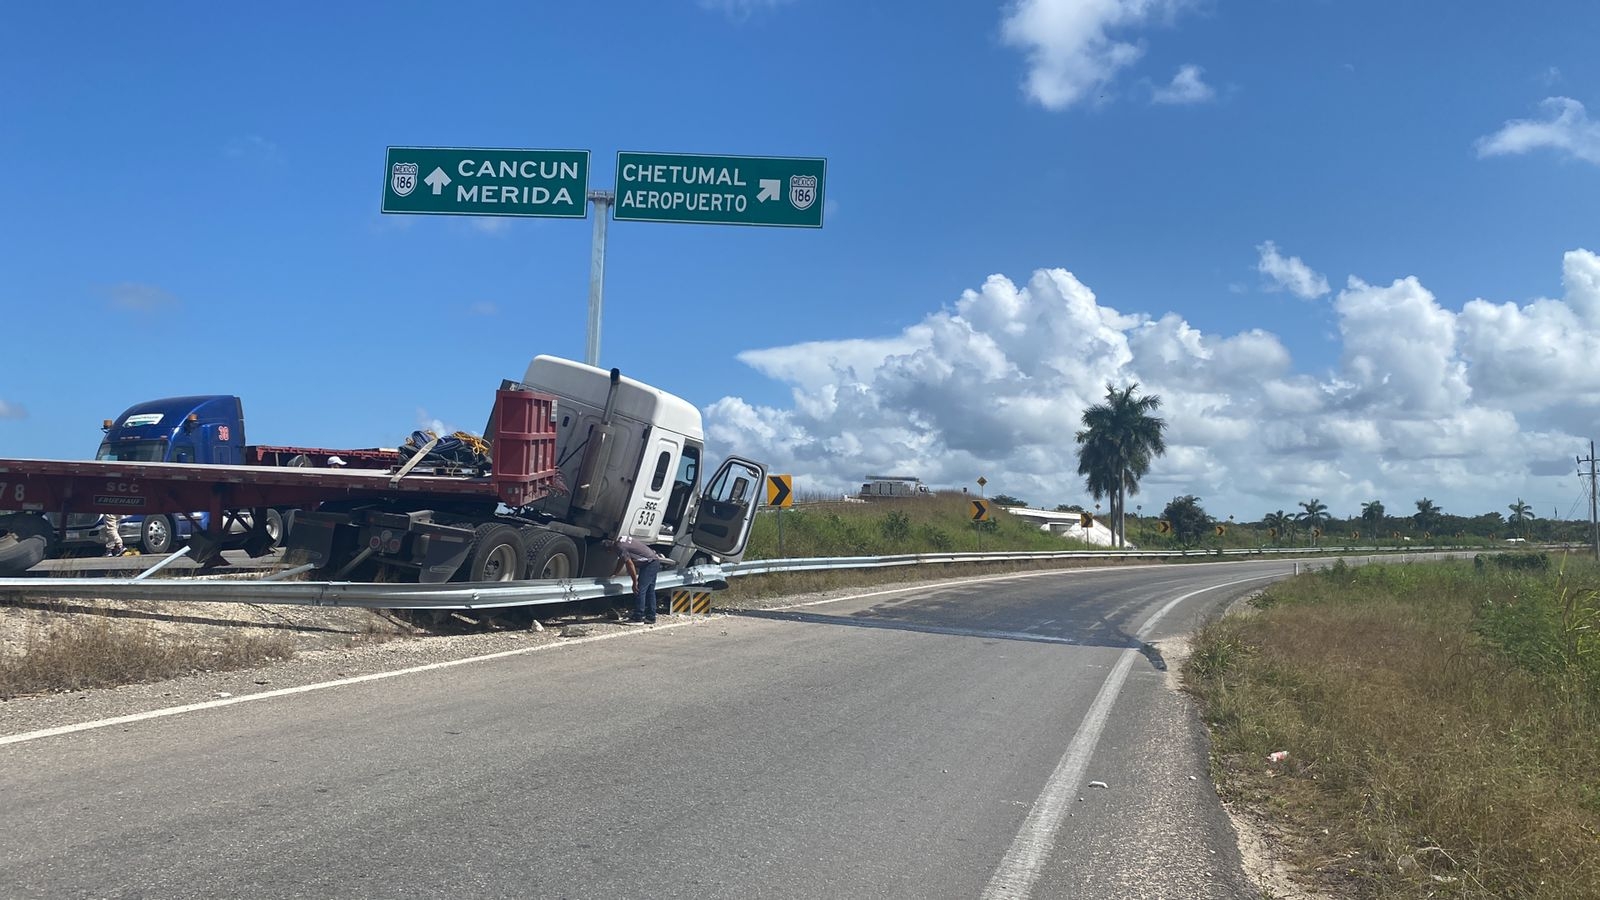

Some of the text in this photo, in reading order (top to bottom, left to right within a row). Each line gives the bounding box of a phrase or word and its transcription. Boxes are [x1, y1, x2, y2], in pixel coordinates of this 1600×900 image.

[458, 159, 578, 179] CANCUN
[623, 163, 746, 186] CHETUMAL
[397, 176, 412, 189] 186
[456, 185, 574, 205] MERIDA
[621, 190, 747, 213] AEROPUERTO
[795, 189, 811, 202] 186
[106, 481, 139, 493] SCC
[645, 501, 657, 510] SCC
[638, 511, 655, 526] 539
